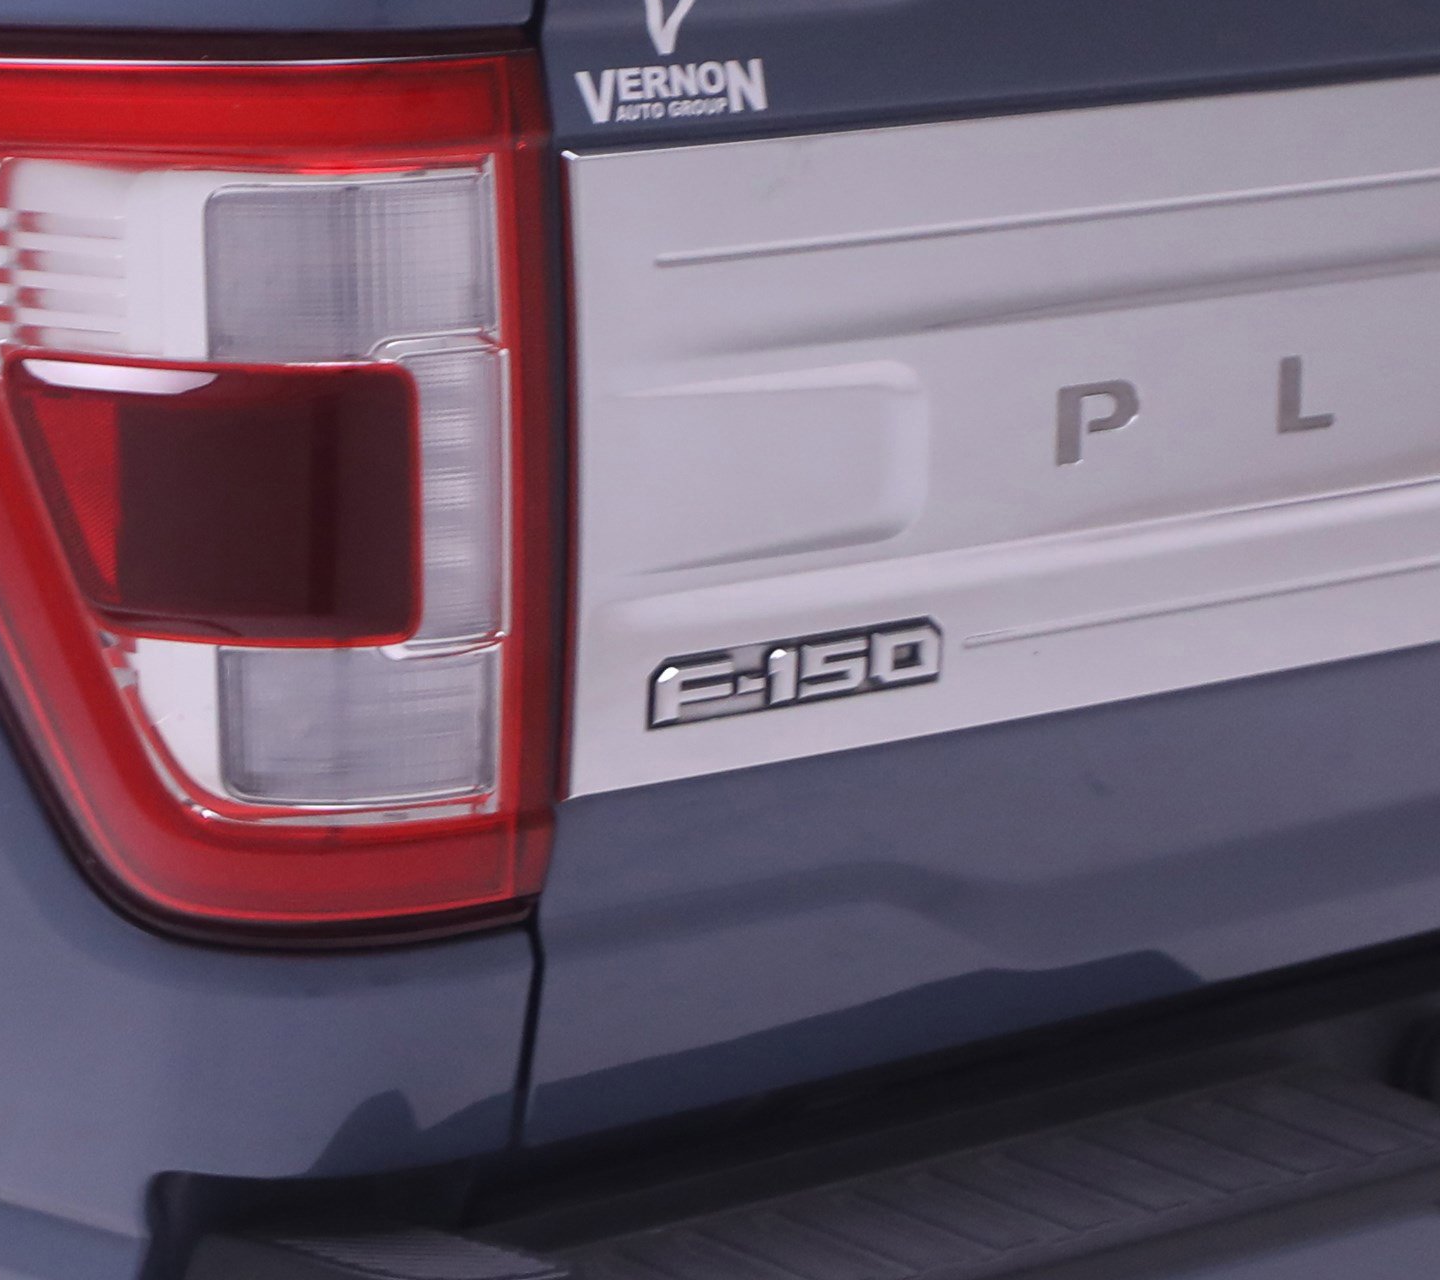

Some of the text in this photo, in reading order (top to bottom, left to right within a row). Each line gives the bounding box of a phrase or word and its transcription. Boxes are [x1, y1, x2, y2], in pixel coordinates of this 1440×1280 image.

[574, 58, 768, 124] VERNON
[615, 99, 666, 122] AUTO
[645, 614, 942, 730] F-150
